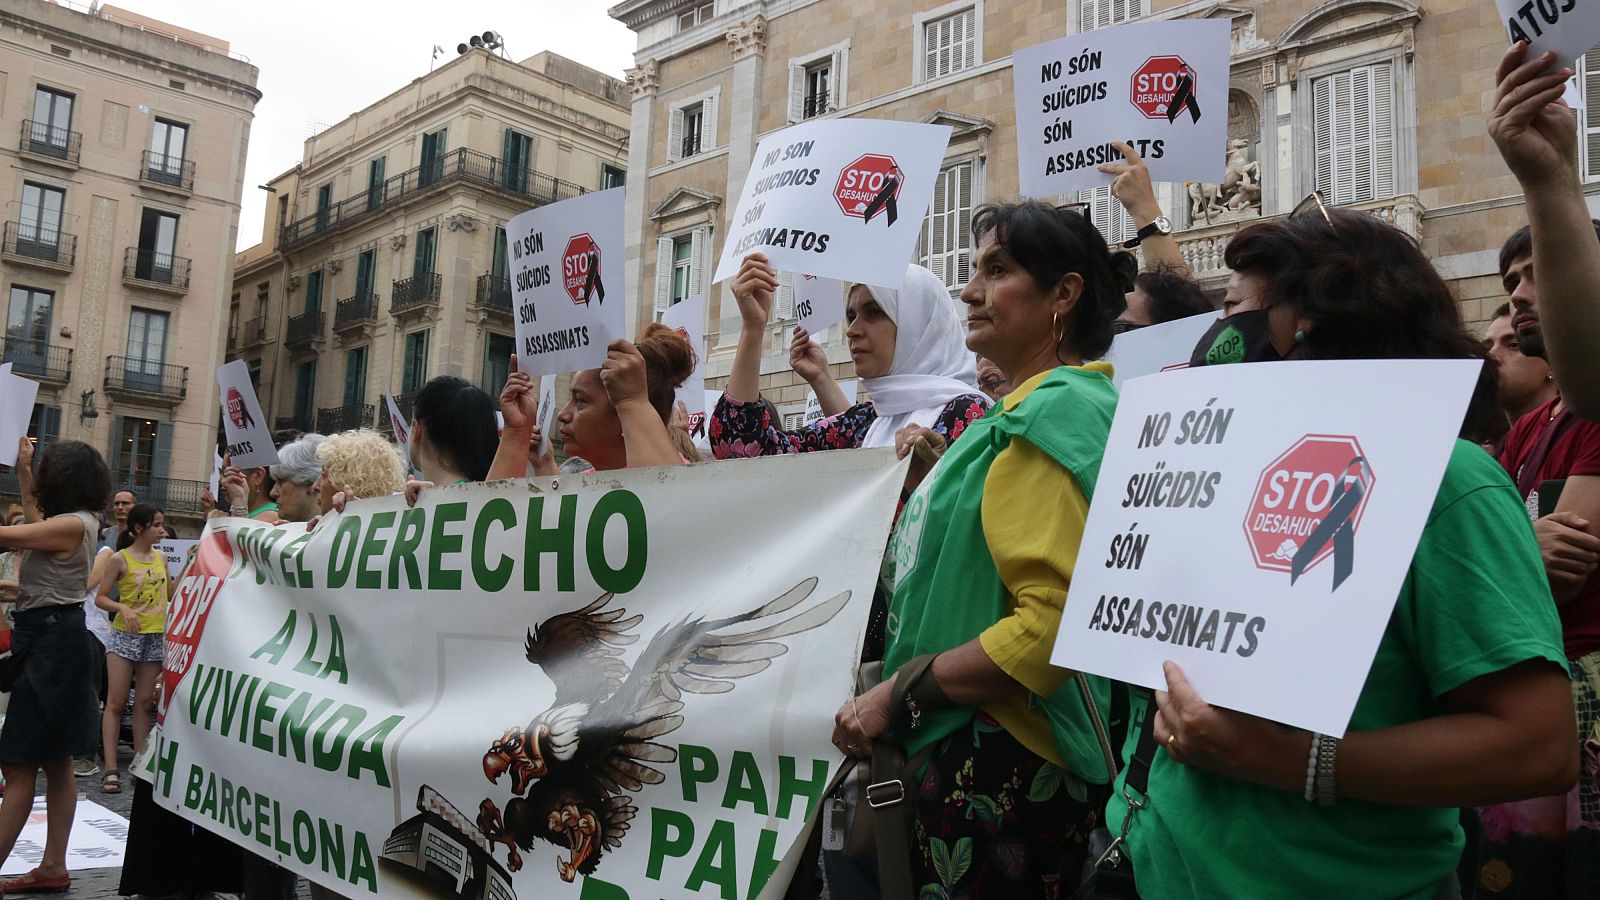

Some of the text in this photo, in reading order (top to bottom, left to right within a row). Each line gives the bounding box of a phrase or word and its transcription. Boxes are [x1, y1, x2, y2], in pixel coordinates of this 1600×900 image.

[1041, 48, 1102, 83] NO SÓN
[1042, 81, 1107, 113] SUÏCIDIS
[1137, 72, 1187, 92] STO
[1137, 93, 1176, 103] DESAHUC
[1043, 118, 1072, 144] SÓN
[761, 140, 815, 169] NO SON
[752, 168, 820, 197] SUICIDIOS
[840, 189, 878, 202] DESAHUC
[844, 169, 896, 191] STO
[513, 228, 543, 261] NO SÓN
[732, 227, 830, 258] ASESINATOS
[516, 265, 550, 293] SUÏCIDIS
[565, 251, 589, 277] STO
[520, 298, 536, 324] SÓN
[525, 325, 590, 356] ASSASSINATS
[1209, 335, 1240, 363] STOP
[228, 398, 242, 413] STO
[1137, 397, 1235, 449] NO SÓN
[1121, 462, 1222, 509] SUÏCIDIS
[1263, 469, 1340, 513] STO
[1253, 512, 1321, 537] DESAHUC
[230, 489, 648, 594] POR EL DERECHO
[1104, 522, 1149, 570] SÓN
[1088, 594, 1266, 658] ASSASSINATS
[250, 609, 349, 685] A LA
[189, 663, 405, 789] VIVIENDA
[679, 743, 830, 823] PAH
[184, 762, 378, 894] BARCELONA
